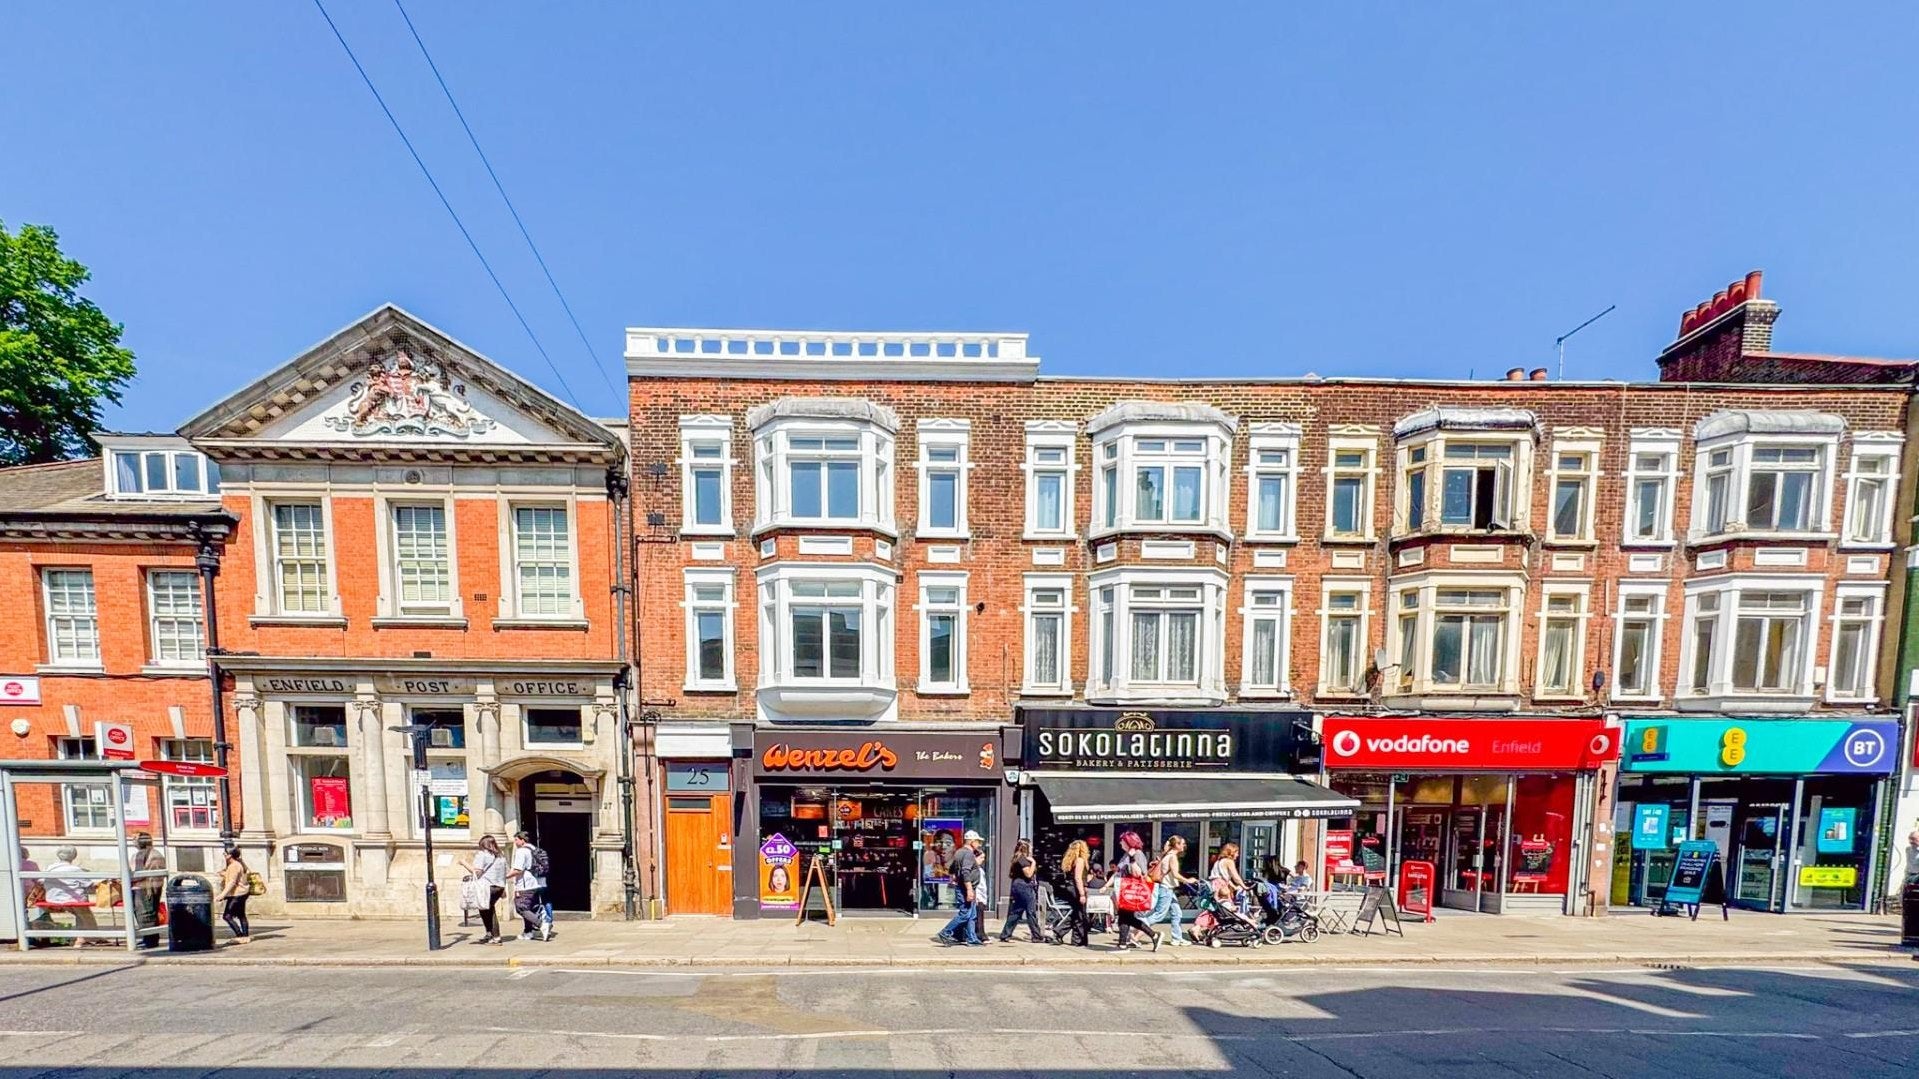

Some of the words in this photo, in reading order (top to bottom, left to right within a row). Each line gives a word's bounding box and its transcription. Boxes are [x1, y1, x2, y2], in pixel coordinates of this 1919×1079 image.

[269, 679, 344, 692] ENFIELD
[404, 680, 450, 693] POST
[513, 682, 579, 694] OFFICE
[1367, 734, 1470, 753] vodafone
[1492, 738, 1543, 754] Enfield
[1853, 741, 1876, 755] BT
[763, 741, 898, 769] Wenzel's
[915, 751, 930, 760] The
[932, 751, 963, 760] Bakers
[1076, 759, 1115, 767] BAKERY
[1126, 760, 1192, 768] PATISSERIE
[686, 768, 710, 785] 25
